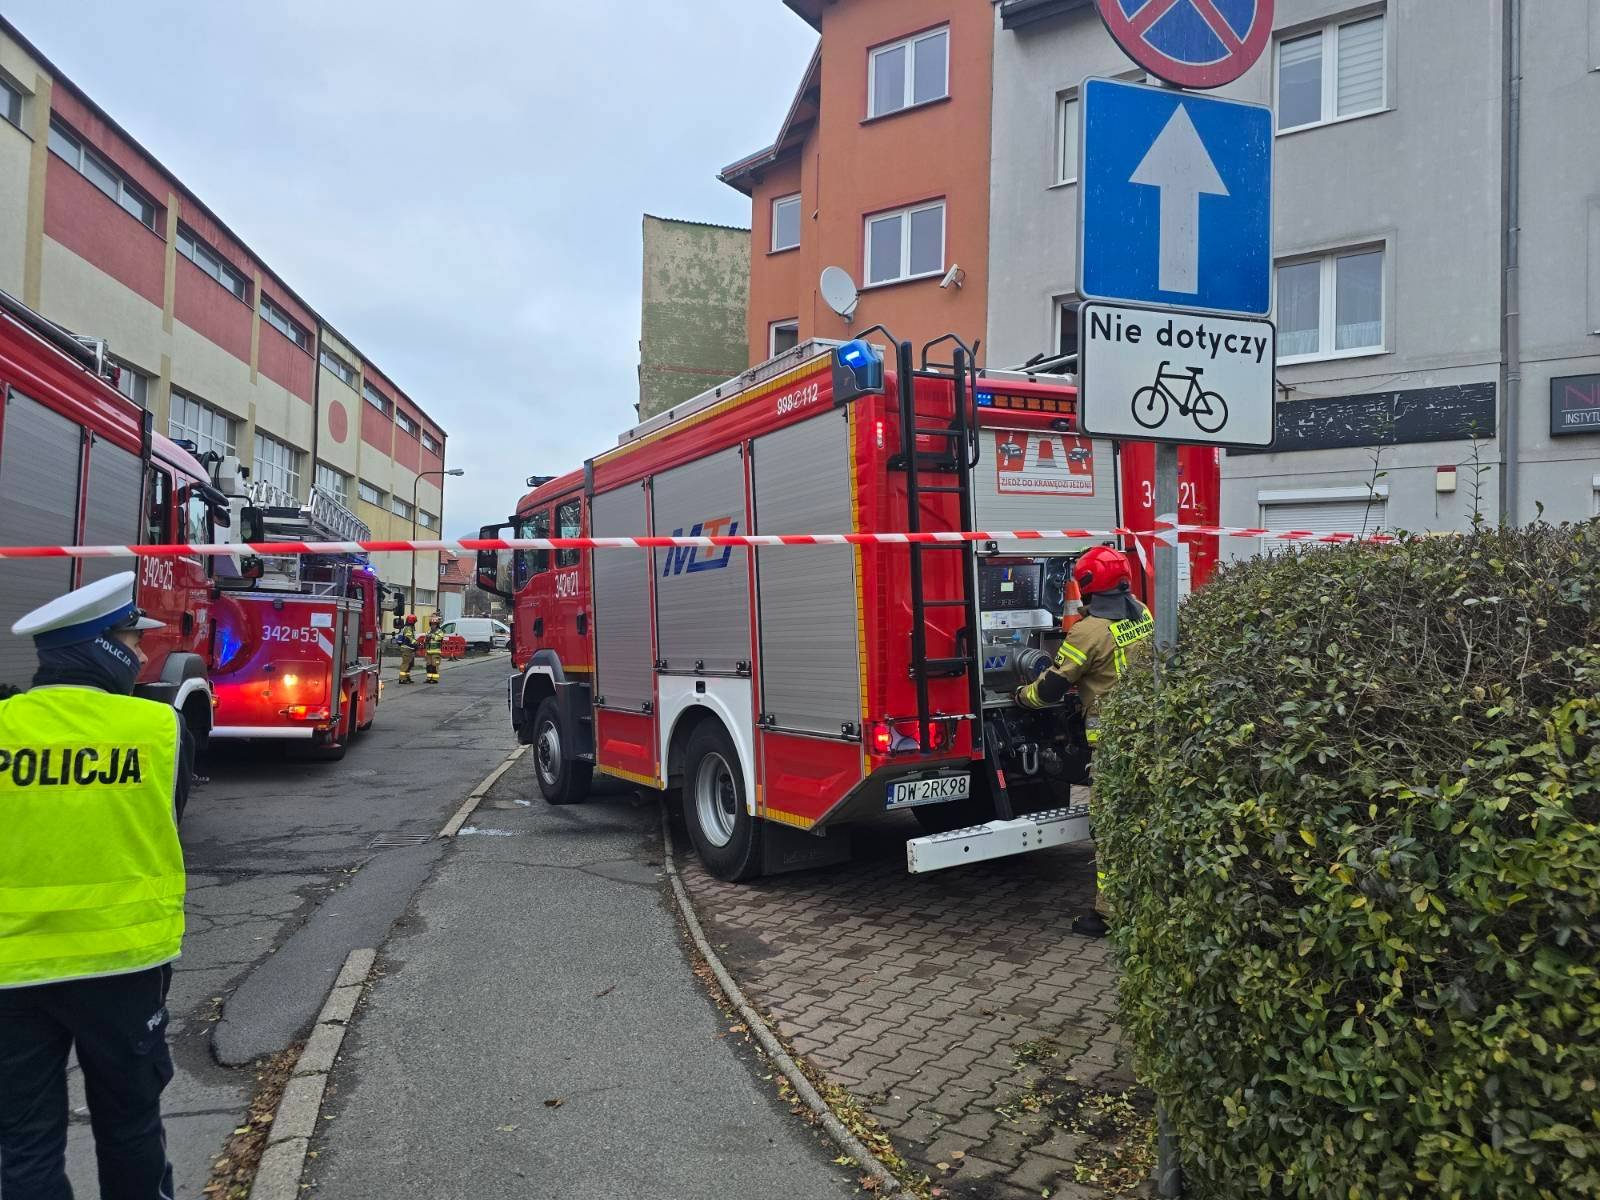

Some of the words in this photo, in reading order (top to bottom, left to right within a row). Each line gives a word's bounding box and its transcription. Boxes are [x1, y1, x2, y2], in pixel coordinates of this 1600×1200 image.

[1091, 312, 1142, 343] Nie
[1156, 320, 1267, 363] dotyczy
[777, 393, 793, 415] 998
[802, 383, 818, 405] 112
[94, 637, 132, 667] POLICJA
[897, 783, 917, 802] DW
[922, 777, 966, 799] 2RK98
